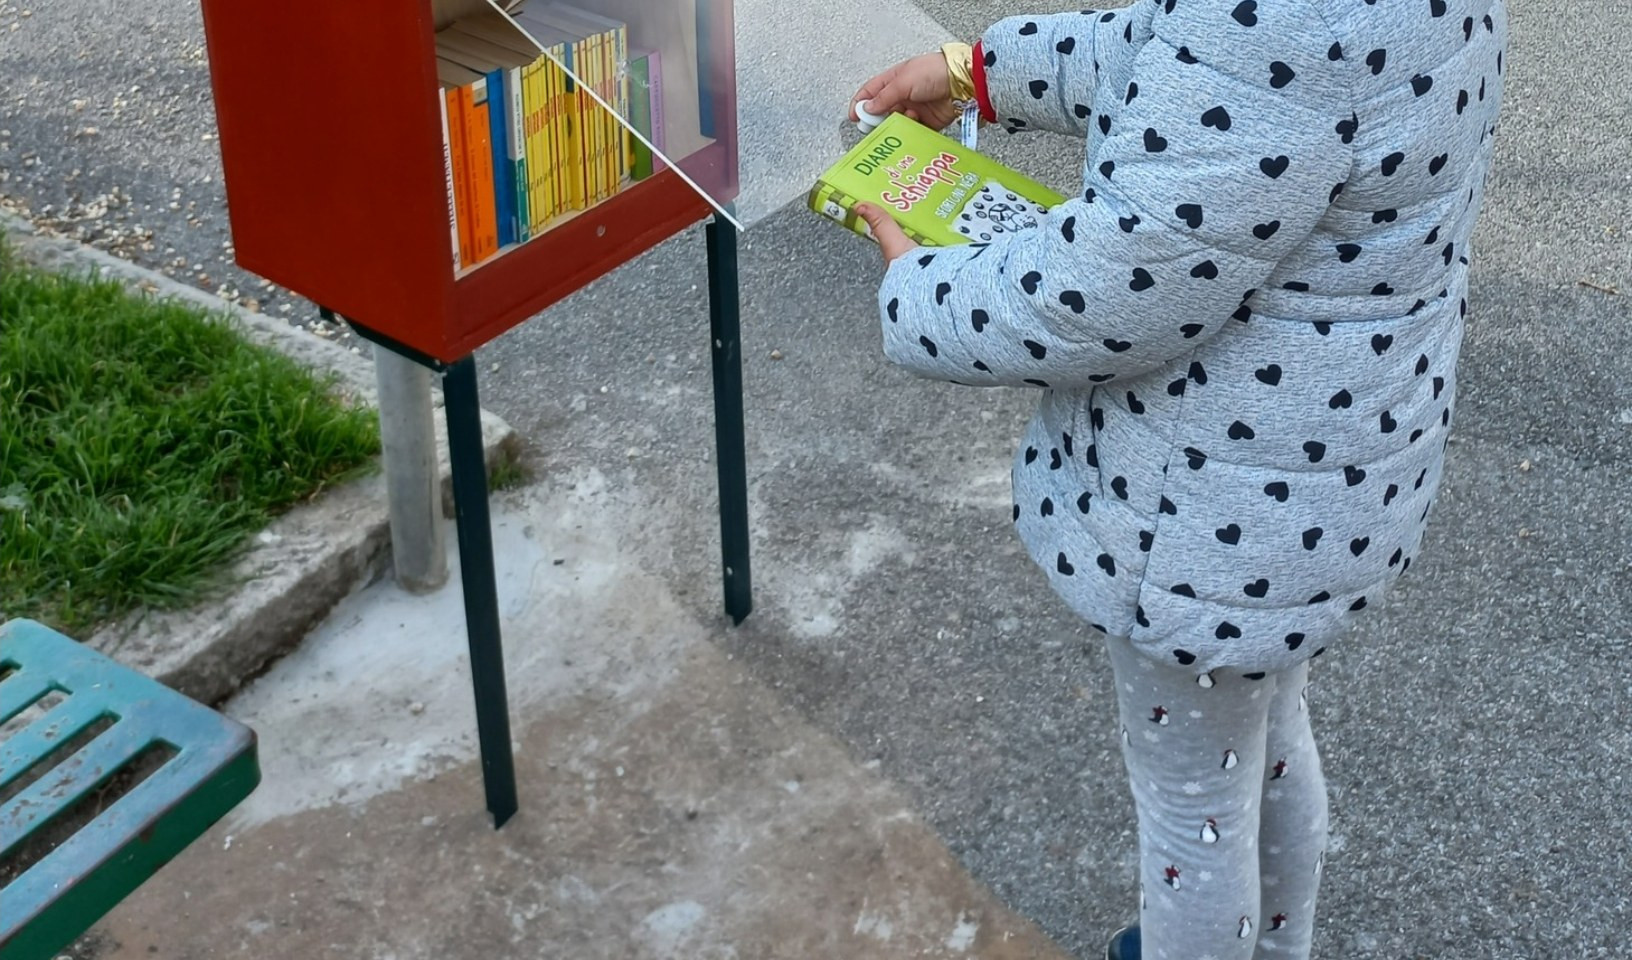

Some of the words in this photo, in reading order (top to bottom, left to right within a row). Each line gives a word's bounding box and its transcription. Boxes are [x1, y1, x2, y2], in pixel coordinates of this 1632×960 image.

[854, 136, 902, 176] DIARIO
[883, 166, 902, 179] di
[897, 154, 916, 170] una
[881, 151, 963, 212] Schiappa
